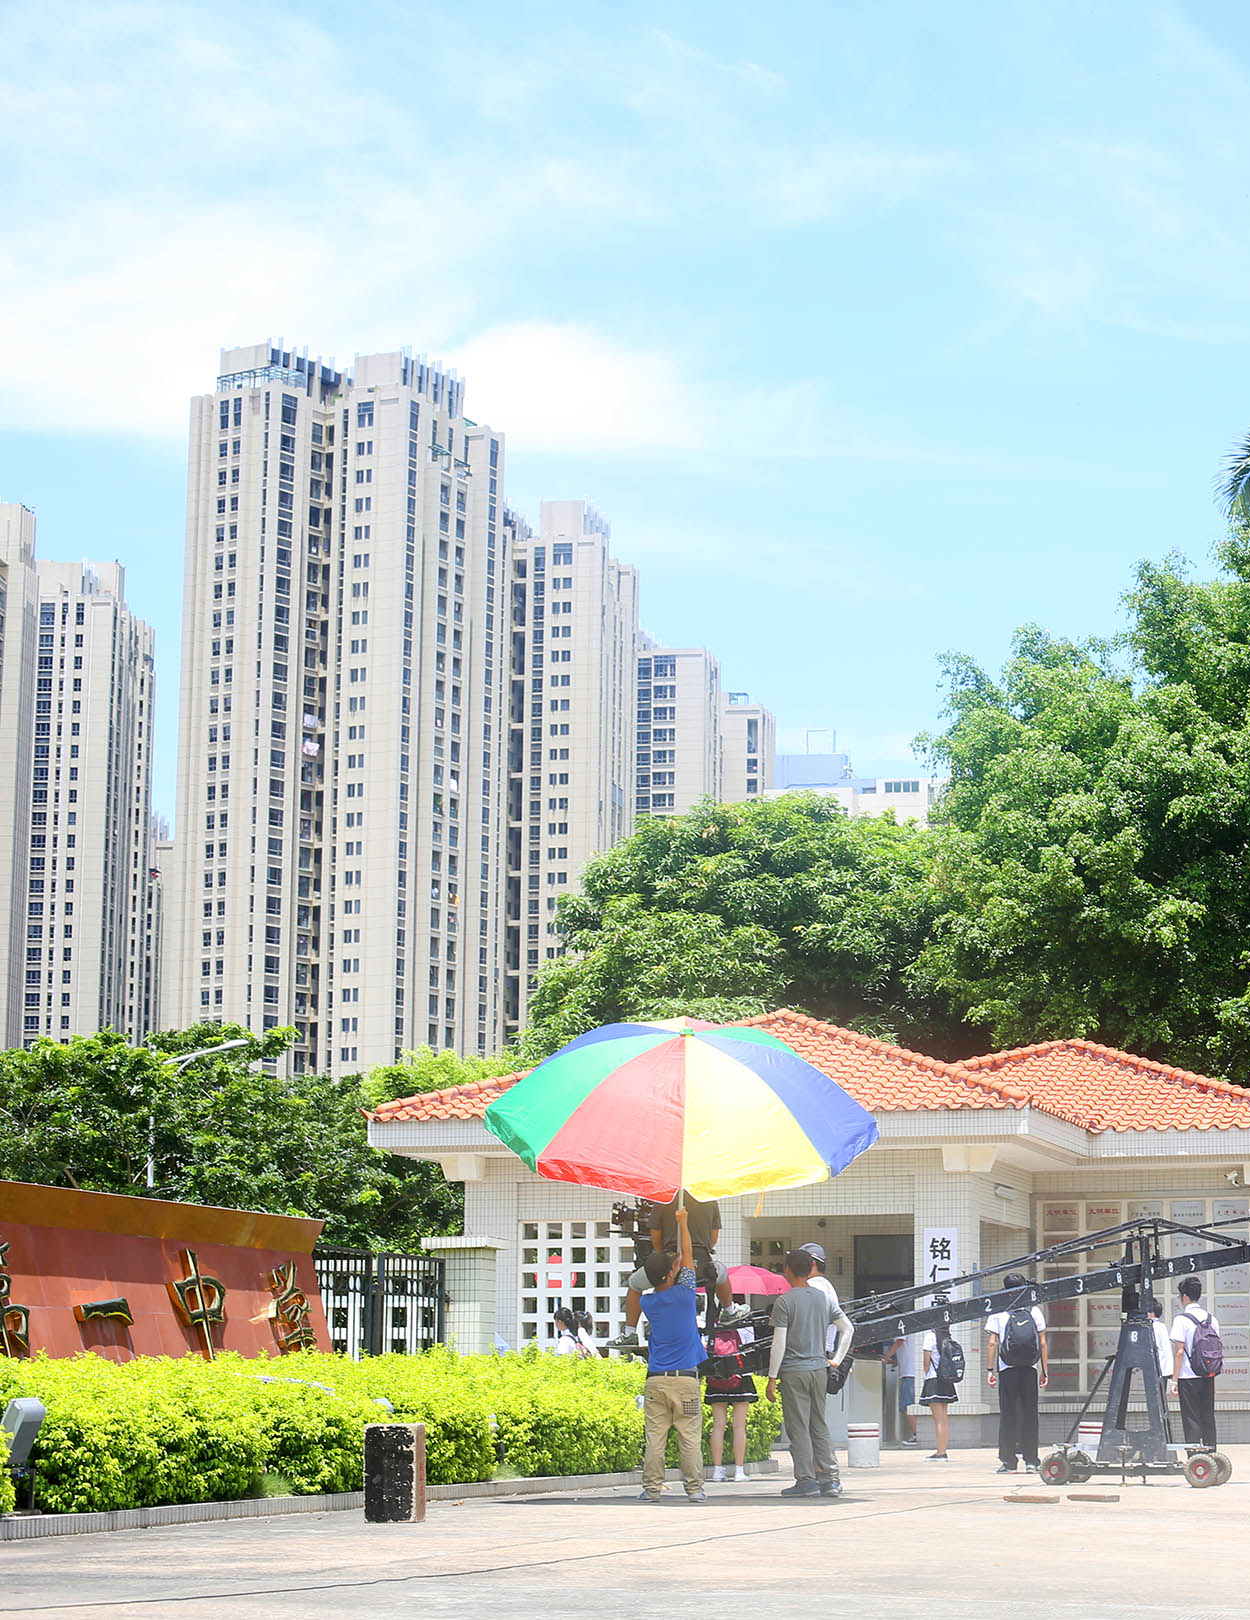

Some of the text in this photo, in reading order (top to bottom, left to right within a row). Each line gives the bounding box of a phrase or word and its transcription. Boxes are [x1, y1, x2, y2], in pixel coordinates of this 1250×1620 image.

[1189, 1257, 1196, 1272] 5
[1076, 1278, 1084, 1293] 3
[984, 1298, 993, 1312] 2
[898, 1319, 906, 1335] 4
